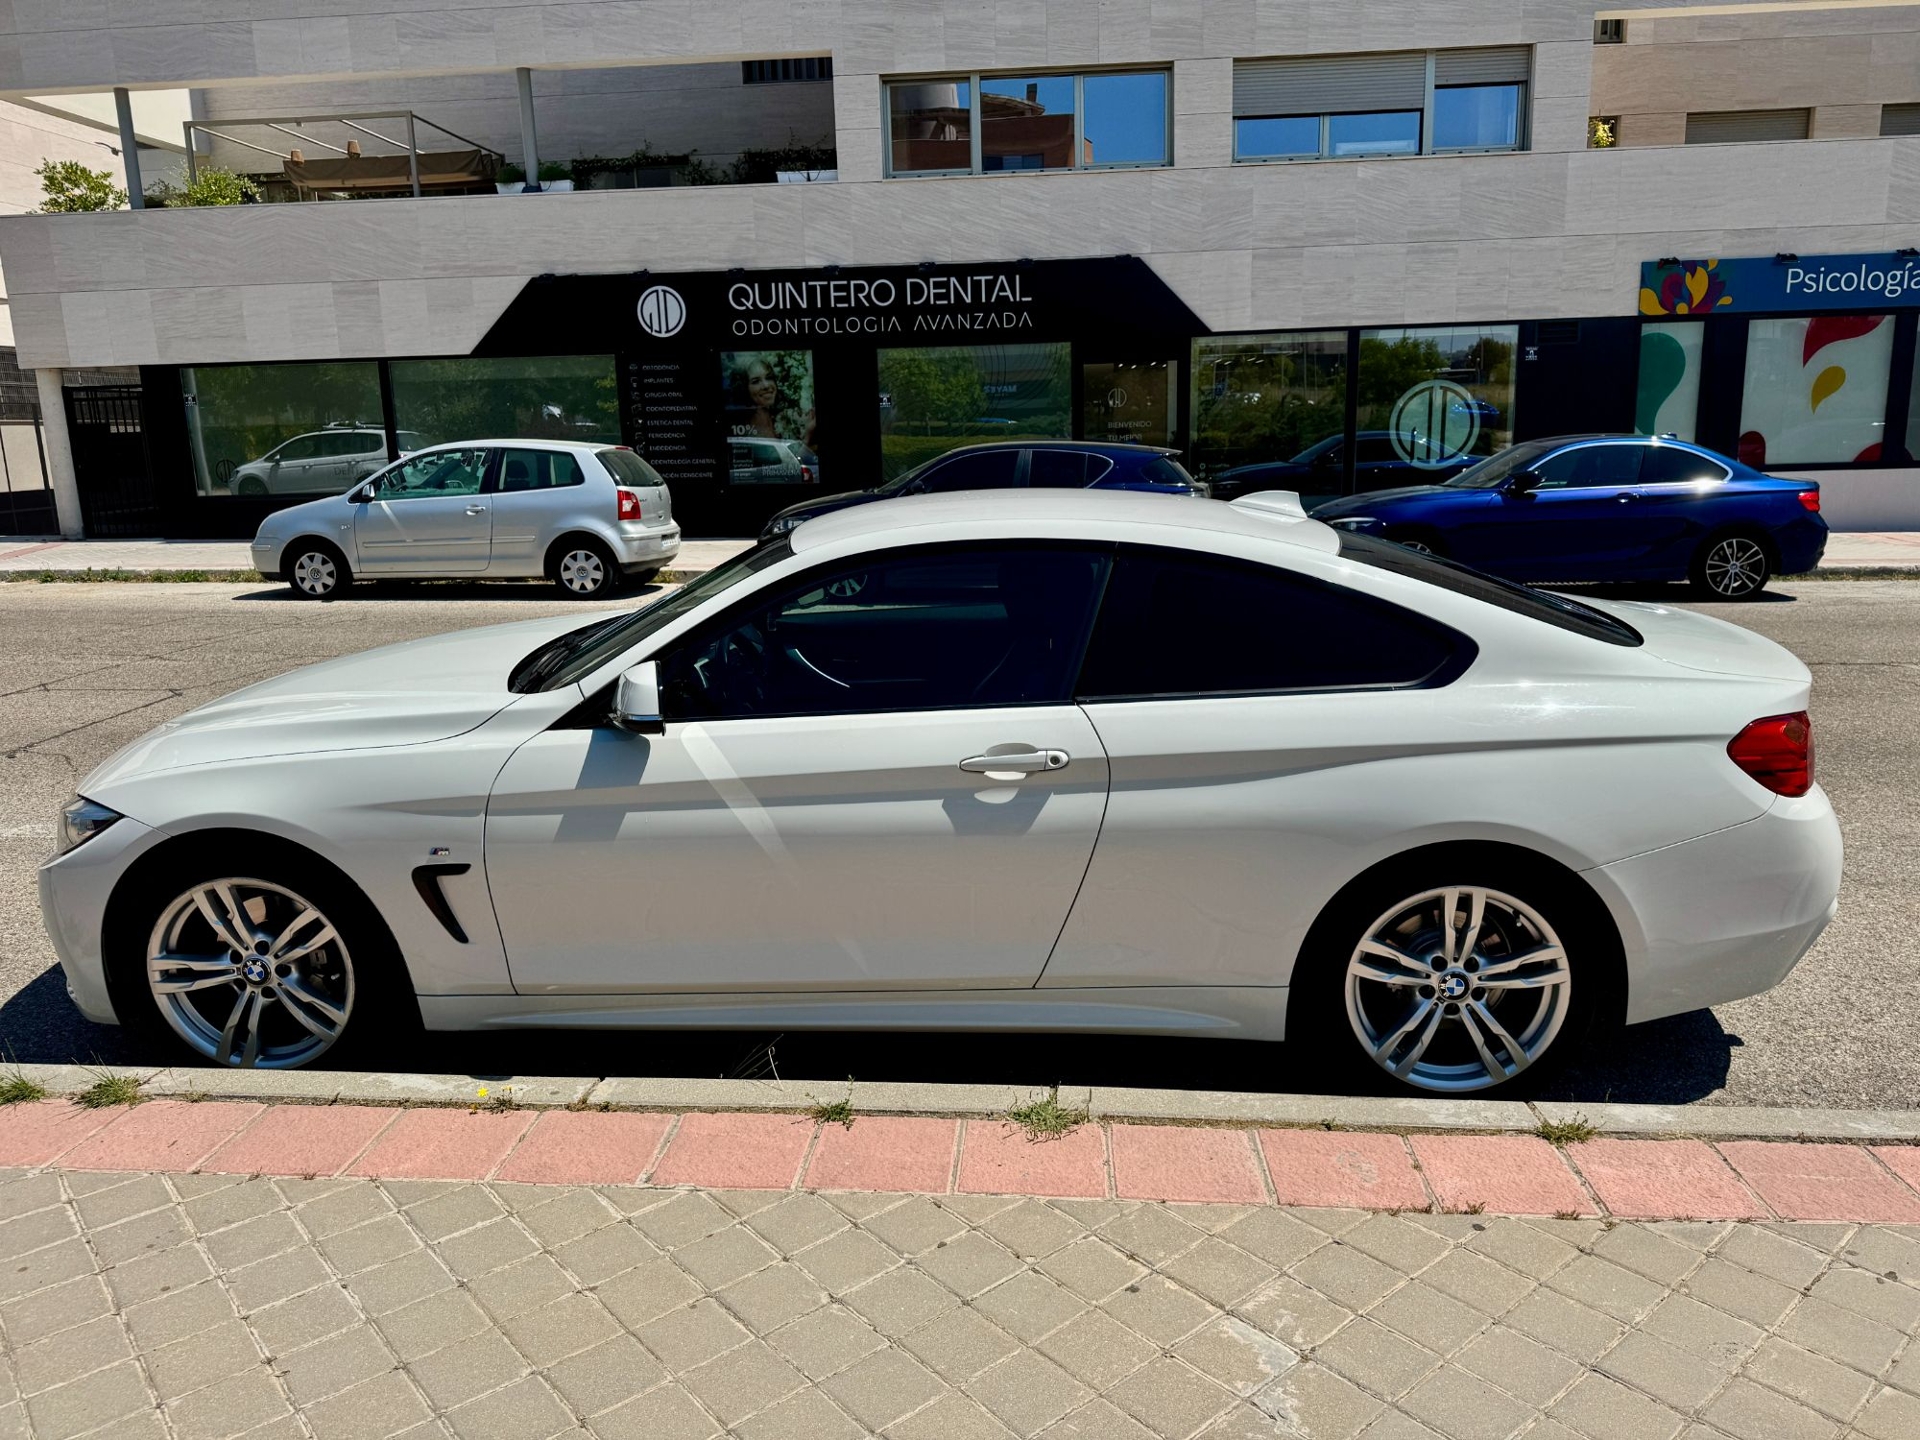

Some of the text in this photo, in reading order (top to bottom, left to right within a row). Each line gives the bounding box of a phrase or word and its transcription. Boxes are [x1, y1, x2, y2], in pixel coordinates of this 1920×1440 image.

[728, 273, 1033, 311] QUINTERO DENTAL
[1786, 262, 1920, 298] Psicología
[732, 310, 1033, 336] ODONTOLOGIA AVANZADA
[731, 424, 758, 436] 10%
[1107, 420, 1152, 429] BIENVENIDO
